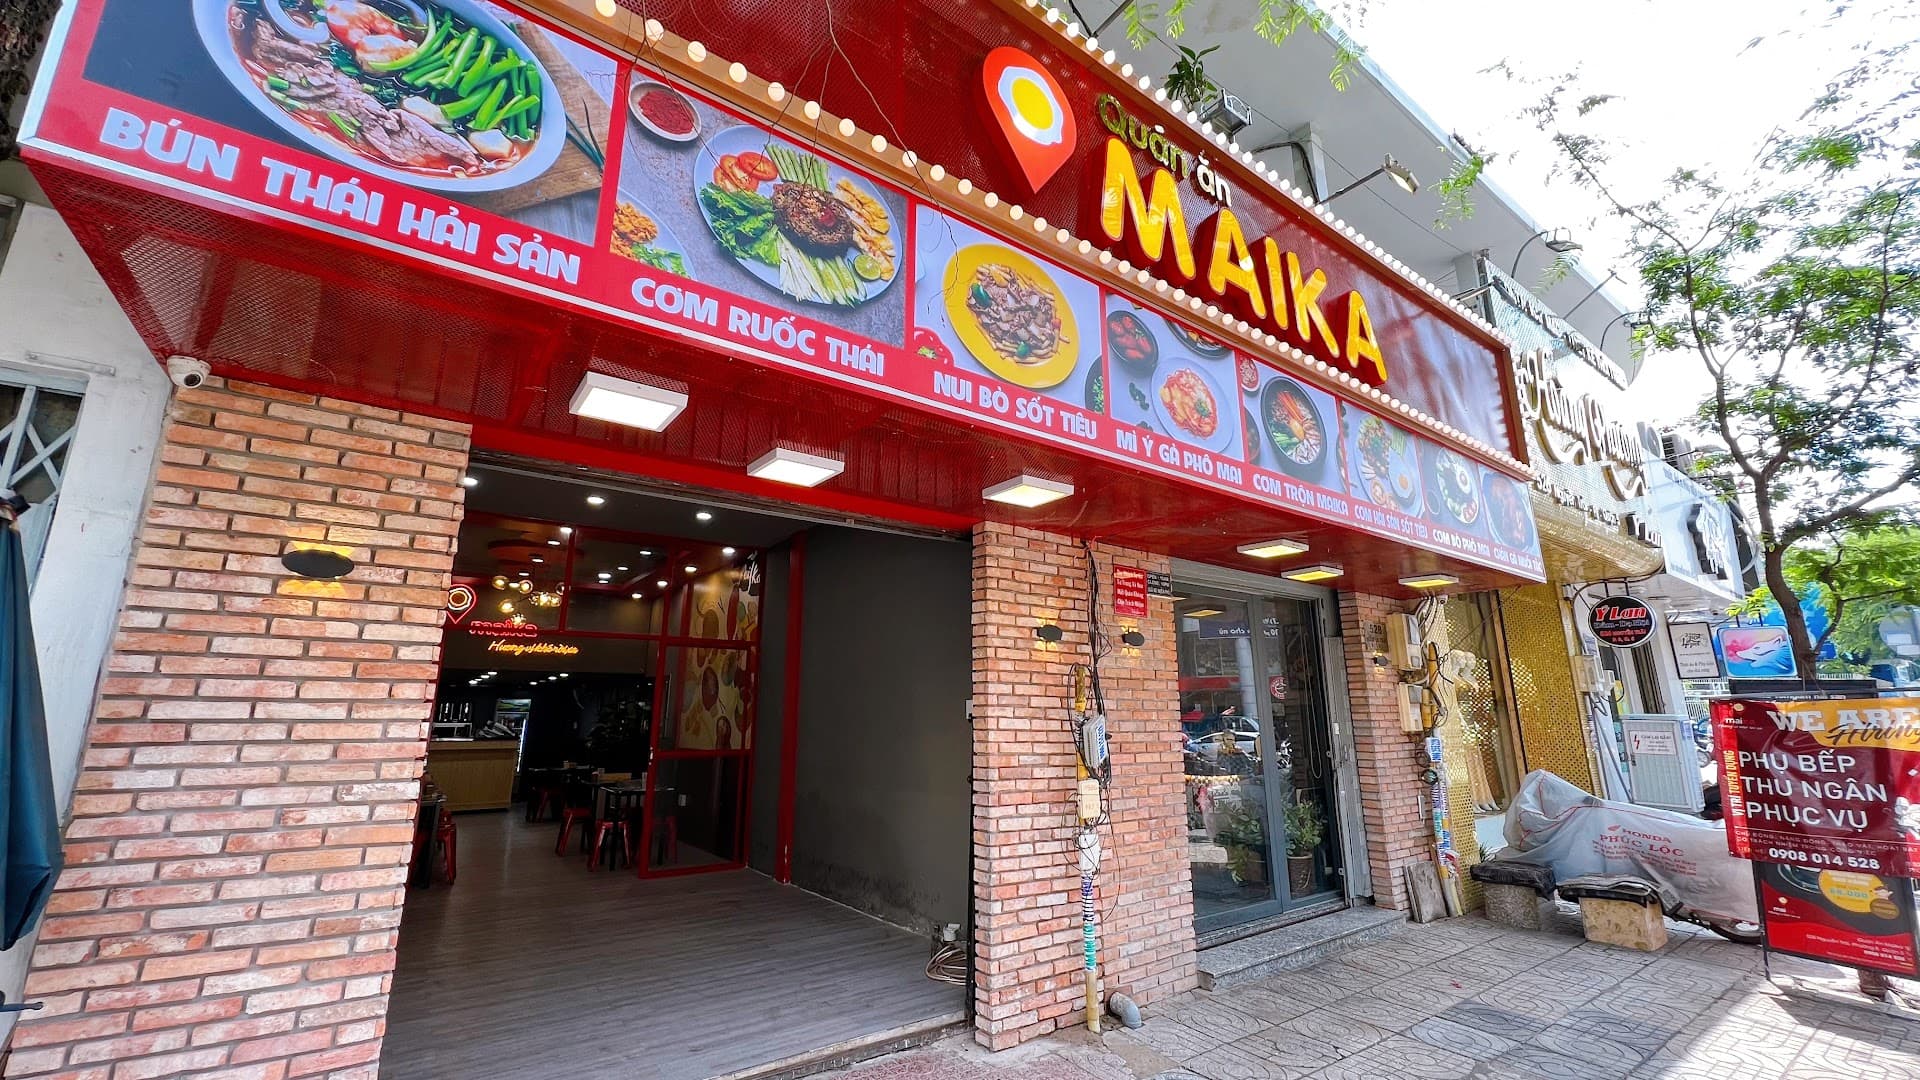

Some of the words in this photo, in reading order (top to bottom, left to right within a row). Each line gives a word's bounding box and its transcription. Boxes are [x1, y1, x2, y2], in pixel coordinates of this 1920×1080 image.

[1098, 94, 1189, 178] Quán
[1197, 150, 1232, 206] ăn
[100, 106, 240, 181] BÚN
[261, 156, 384, 226] THÁI
[399, 204, 480, 256] HẢI
[493, 233, 580, 285] SẢN
[1101, 136, 1388, 382] MAIKA
[631, 277, 718, 327] CƠM
[728, 305, 816, 356] RUỐC
[825, 339, 885, 378] THÁI
[933, 371, 973, 402] NUI
[978, 385, 1009, 414] BÒ
[1015, 396, 1055, 427] SỐT
[1060, 410, 1098, 440] TIÊU
[1116, 429, 1137, 454] MÌ
[1142, 435, 1153, 457] Ý
[1158, 443, 1180, 466] GÀ
[1184, 453, 1213, 476] PHÔ
[1217, 461, 1243, 485] MAI
[1253, 473, 1281, 497] CƠM
[1284, 482, 1315, 508] TRỘN
[1317, 493, 1349, 517] MAIKA
[1609, 606, 1647, 620] Lan
[1766, 709, 1825, 732] WE
[1837, 708, 1920, 730] ARE
[1723, 750, 1738, 770] DỤNG
[1738, 751, 1789, 775] PHỤ
[1798, 748, 1856, 773] BẾP
[1728, 795, 1743, 808] TRÍ
[1740, 775, 1793, 797] THU
[1802, 778, 1888, 802] NGÂN
[1746, 801, 1819, 829] PHỤC
[1827, 808, 1869, 833] VỤ
[1600, 833, 1642, 848] PHÚC
[1649, 844, 1685, 857] LỘC
[1622, 828, 1672, 843] HONDA
[1768, 848, 1807, 862] 0908
[1811, 854, 1843, 867] 014
[1847, 857, 1881, 870] 528
